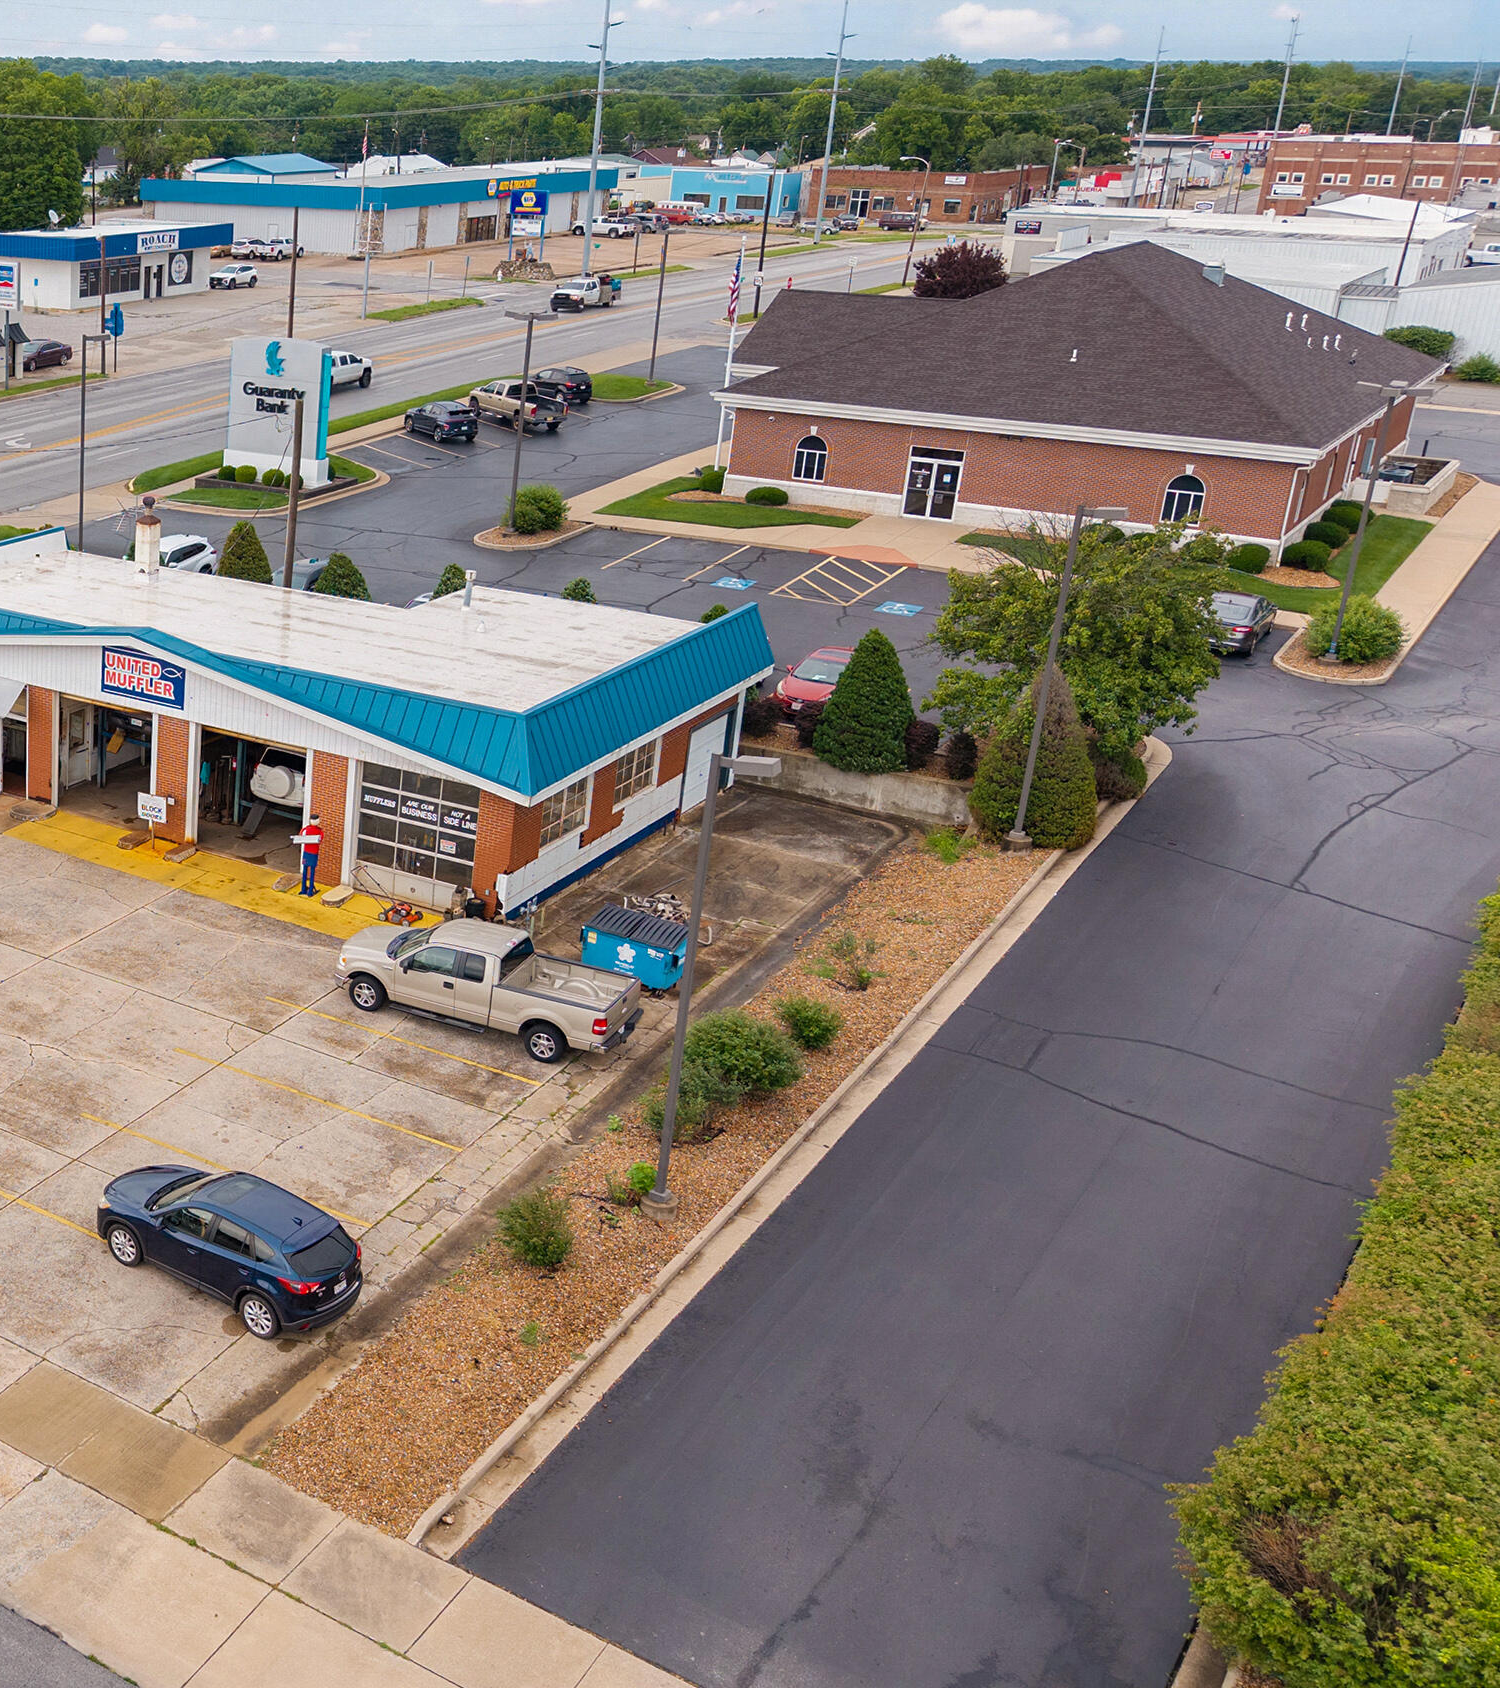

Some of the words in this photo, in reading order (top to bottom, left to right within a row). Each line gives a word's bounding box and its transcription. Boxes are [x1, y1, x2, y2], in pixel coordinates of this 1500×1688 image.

[141, 234, 176, 247] ROACH
[243, 381, 306, 400] Guaranty
[256, 398, 290, 414] Bank
[105, 652, 161, 678] UNITED
[105, 669, 174, 698] MUFFLER
[364, 794, 396, 808] MUFFLERS
[406, 800, 419, 809] ARE
[421, 803, 435, 811] OUR
[401, 806, 437, 821] BUSINESS
[451, 810, 464, 818] NOT
[443, 816, 459, 827] SIDE
[461, 821, 477, 831] LINE
